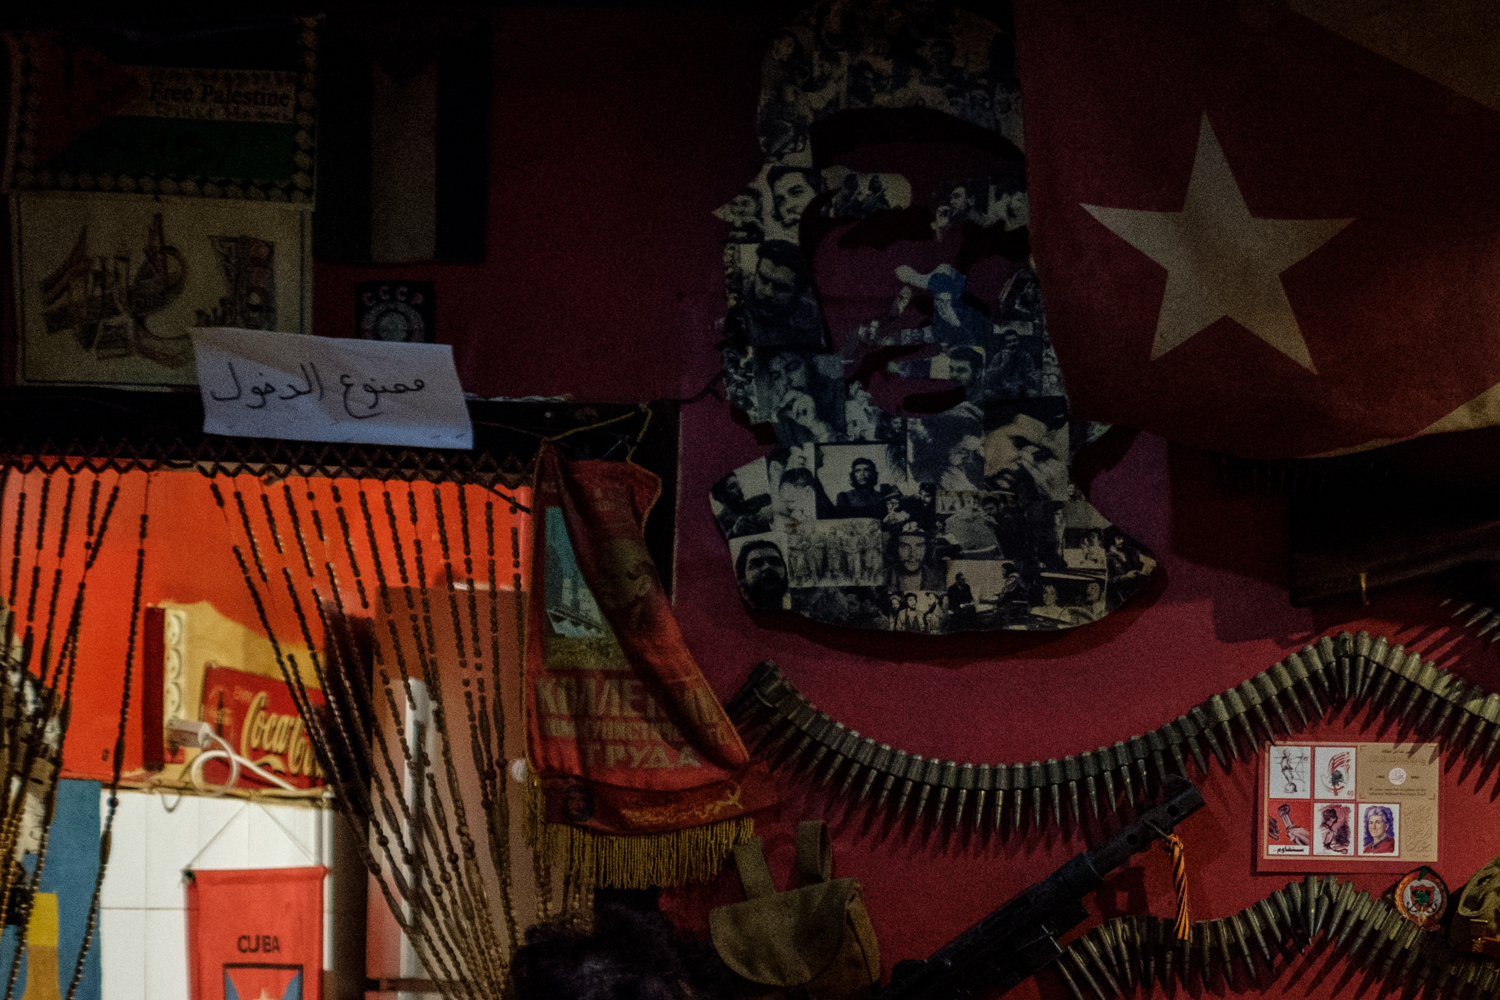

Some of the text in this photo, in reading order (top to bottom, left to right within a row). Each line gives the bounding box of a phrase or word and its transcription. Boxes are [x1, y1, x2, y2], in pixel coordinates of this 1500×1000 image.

[150, 81, 290, 107] Free Palestine
[210, 361, 325, 411] الدخول
[584, 745, 702, 769] ТРУДА
[237, 934, 281, 954] CUBA
